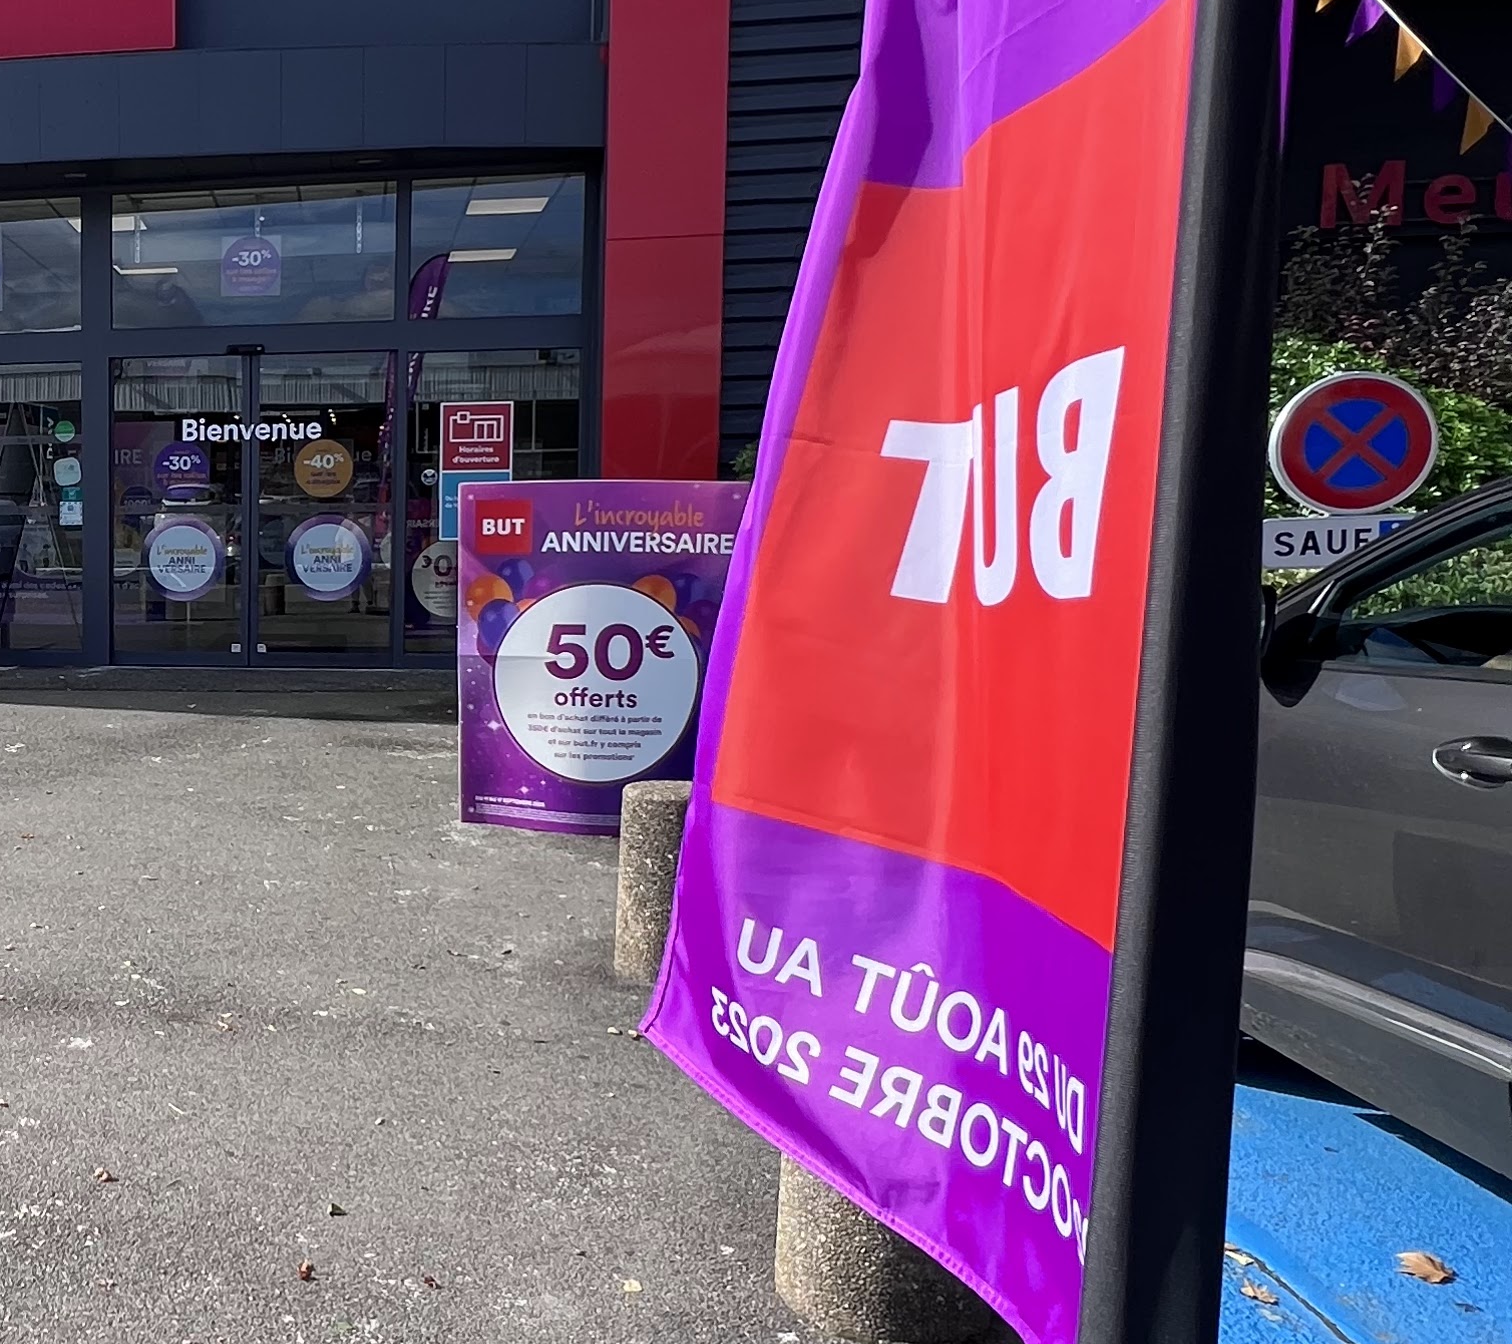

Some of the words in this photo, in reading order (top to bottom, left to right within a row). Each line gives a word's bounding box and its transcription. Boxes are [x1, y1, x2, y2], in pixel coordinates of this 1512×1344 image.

[232, 249, 271, 267] -30%
[181, 418, 323, 443] Bienvenue
[459, 445, 494, 454] Horaires
[162, 454, 201, 471] -30%
[303, 453, 344, 469] -40%
[452, 456, 500, 464] d'ouverture
[574, 499, 704, 533] L'incroyable
[482, 517, 525, 535] BUT
[541, 531, 734, 554] ANNIVERSAIRE
[168, 556, 196, 565] ANNI
[313, 555, 342, 565] ANNI
[157, 564, 206, 574] VERSAIRE
[302, 563, 353, 574] VERSAIRE
[544, 623, 676, 682] 50€
[554, 687, 638, 709] offerts
[556, 713, 588, 722] d'achat
[627, 716, 650, 725] partir
[550, 725, 581, 734] d'achat
[628, 728, 662, 737] magasin
[573, 739, 598, 748] but.fr
[607, 740, 642, 750] compris
[569, 751, 581, 760] les
